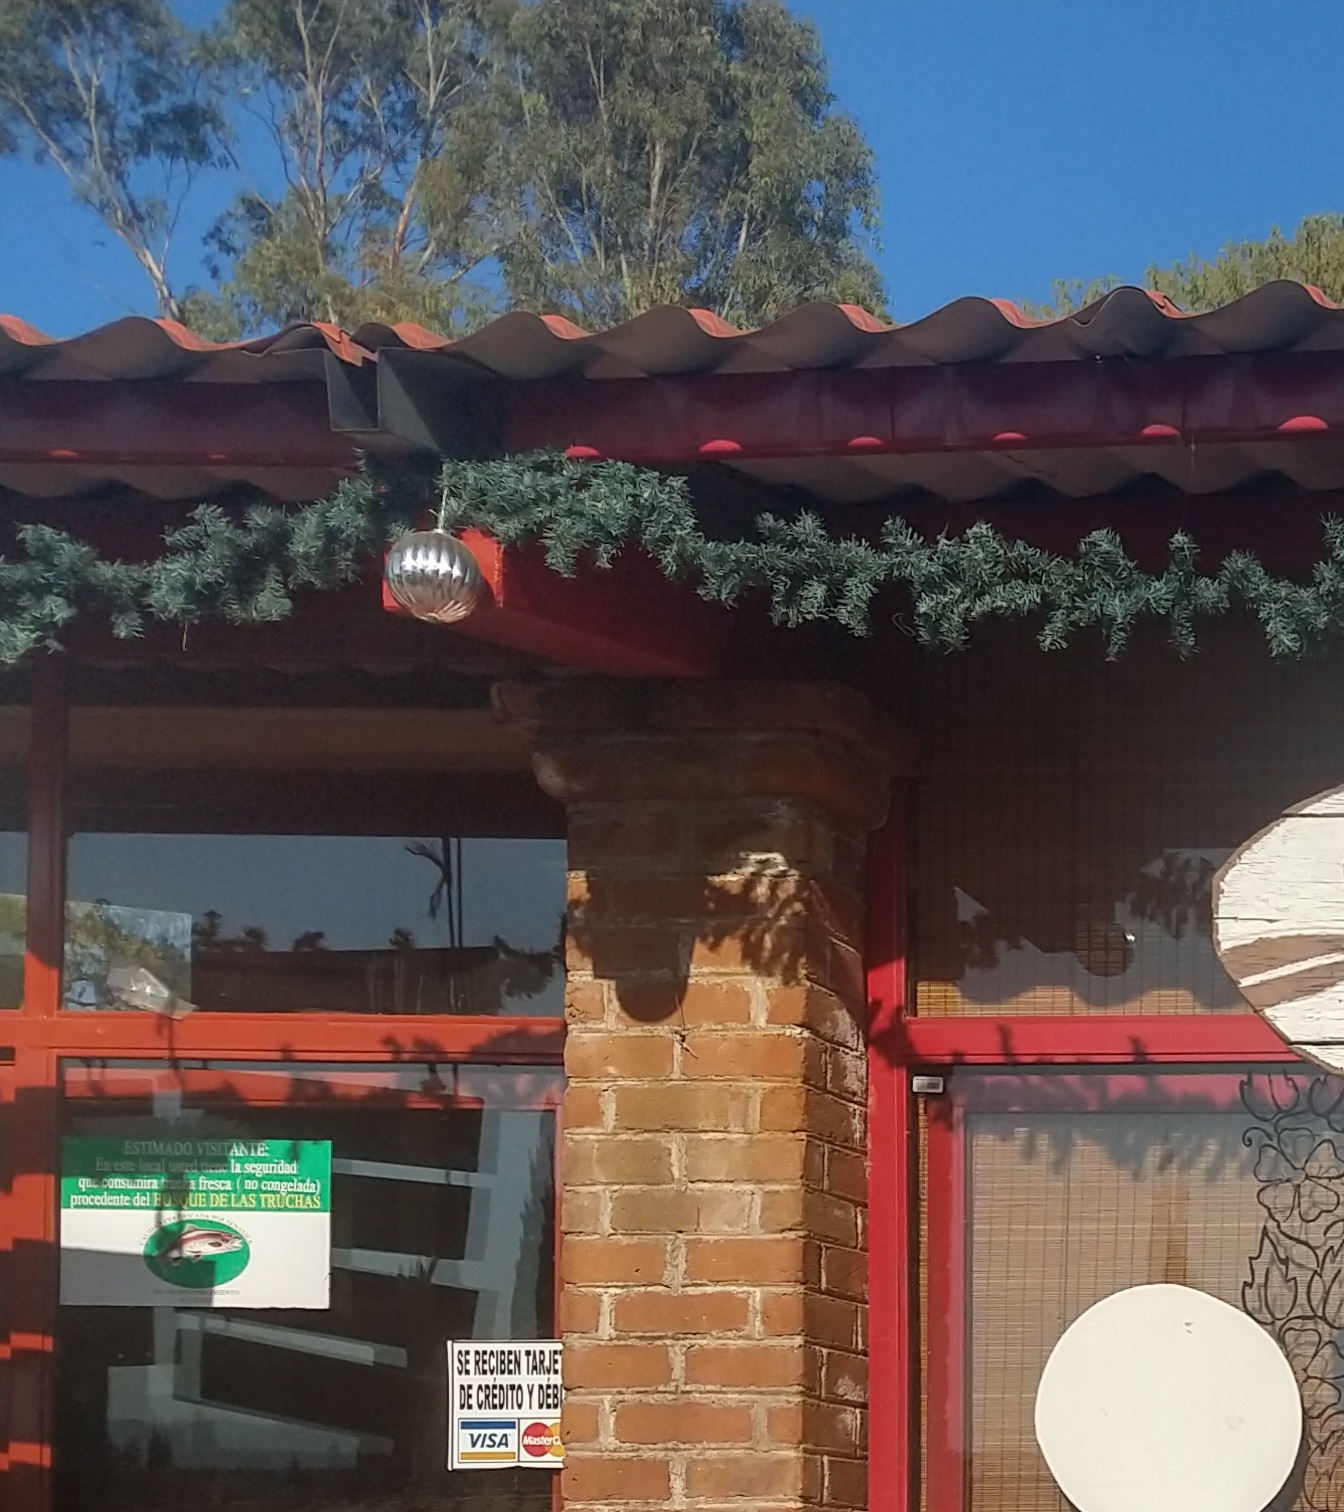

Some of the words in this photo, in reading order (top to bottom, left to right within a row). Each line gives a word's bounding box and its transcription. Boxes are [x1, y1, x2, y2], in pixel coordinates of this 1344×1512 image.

[124, 1141, 193, 1156] ESTIMADO
[231, 1159, 242, 1173] la
[244, 1159, 298, 1177] seguridad
[78, 1177, 99, 1191] que
[199, 1176, 232, 1190] fresca
[70, 1191, 131, 1209] procedente
[133, 1191, 150, 1206] del
[210, 1193, 227, 1208] DE
[231, 1193, 256, 1208] LAS
[260, 1194, 321, 1209] TRUCHAS
[457, 1349, 470, 1376] SE
[474, 1349, 521, 1376] RECIBEN
[459, 1384, 473, 1410] DE
[476, 1377, 523, 1410] CRÉDITO
[527, 1383, 535, 1410] Y
[468, 1433, 509, 1448] VISA
